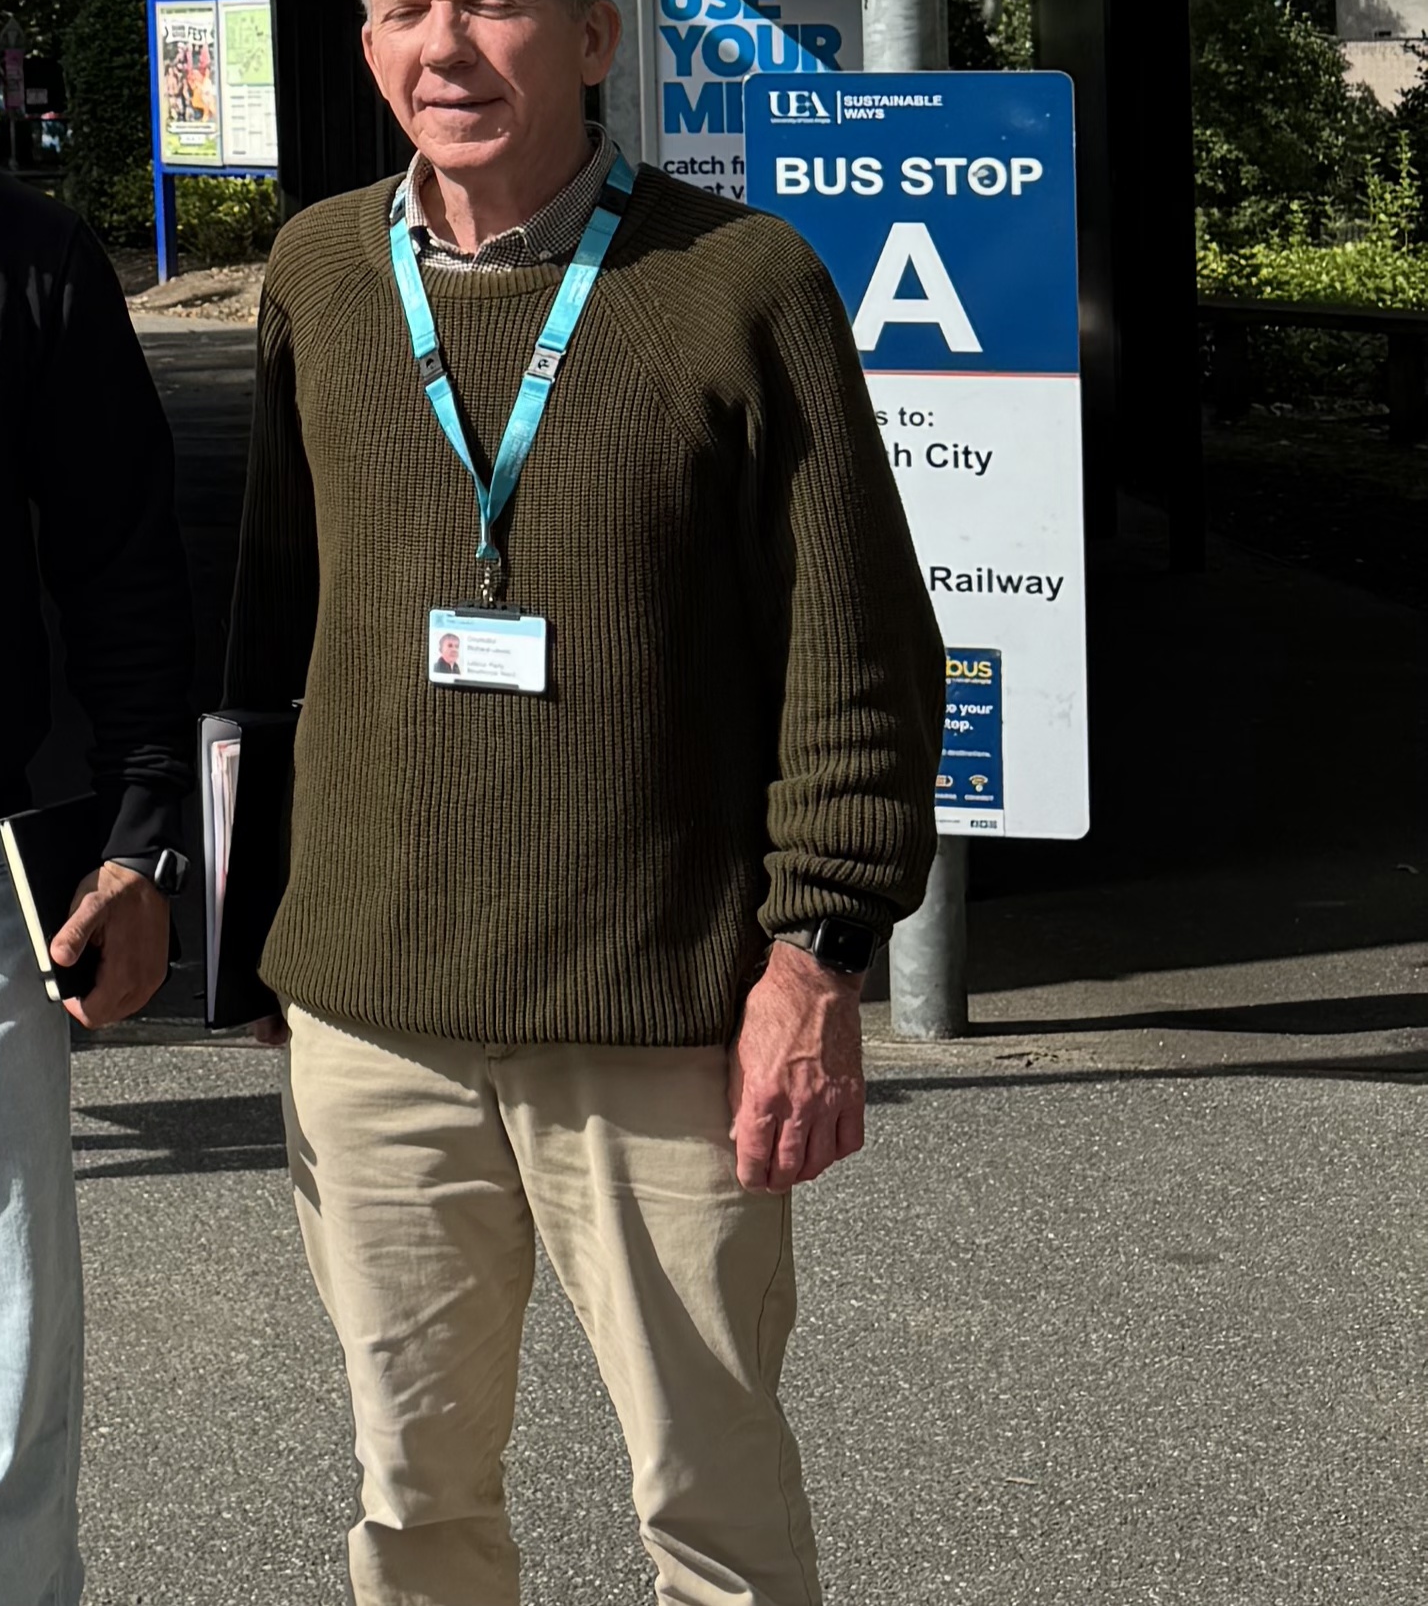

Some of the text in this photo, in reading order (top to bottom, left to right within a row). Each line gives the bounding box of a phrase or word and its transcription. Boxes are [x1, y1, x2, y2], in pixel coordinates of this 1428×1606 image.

[660, 24, 843, 77] YOUR
[768, 90, 830, 116] UEA
[843, 94, 943, 107] SUSTAINABLE
[844, 108, 885, 120] WAYS
[664, 155, 725, 174] catch
[776, 157, 1044, 196] BUS STOP
[852, 222, 984, 353] A
[898, 407, 935, 427] to:
[926, 443, 993, 476] City
[929, 566, 1064, 601] Railway
[958, 704, 994, 717] your
